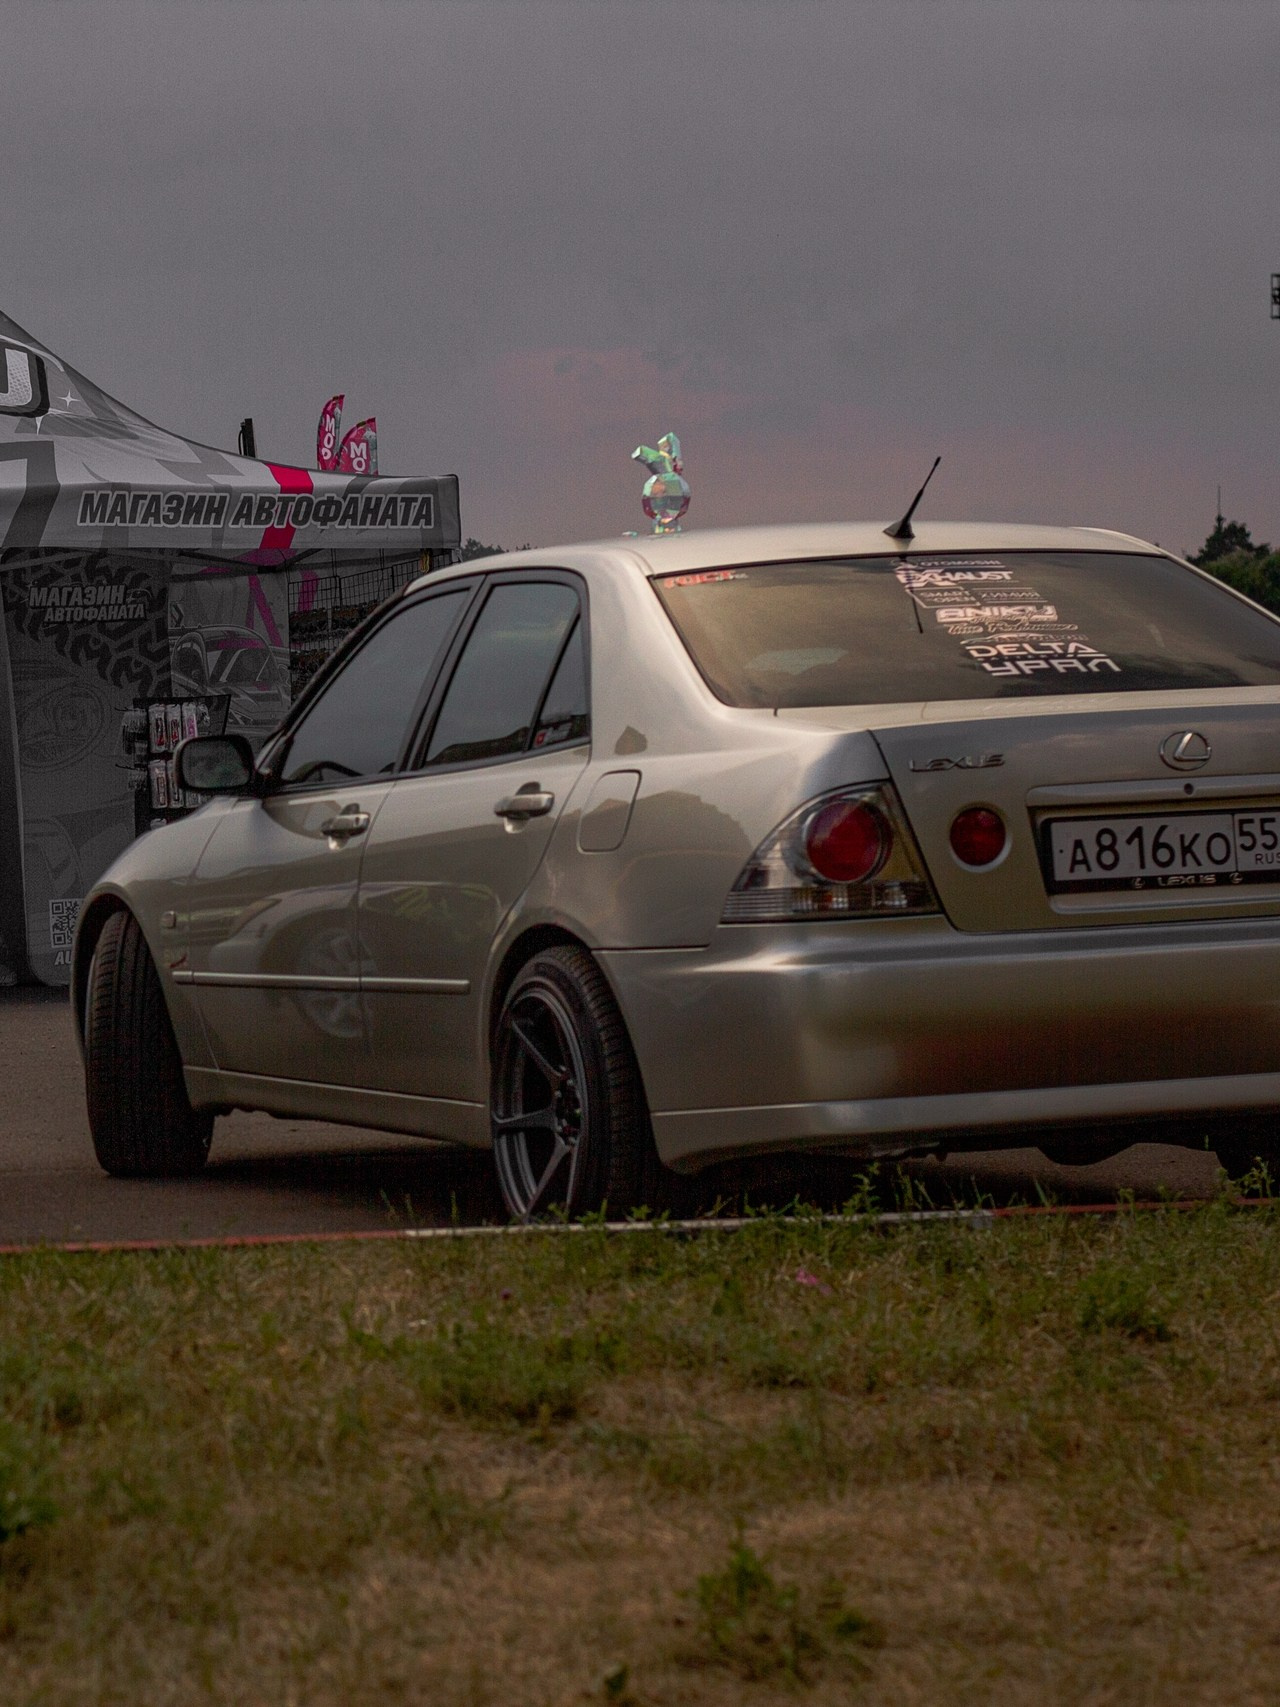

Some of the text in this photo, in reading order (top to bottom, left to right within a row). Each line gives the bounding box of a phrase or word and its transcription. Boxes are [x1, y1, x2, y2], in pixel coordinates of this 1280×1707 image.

[78, 491, 434, 528] МАГАЗИН АВТОФАНАТА
[29, 585, 126, 607] МАГАЗИН
[44, 604, 146, 622] АВТОФАНАТА
[966, 642, 1108, 658] DELTA
[908, 753, 1006, 772] LEXUS
[1157, 875, 1217, 887] LEXUS
